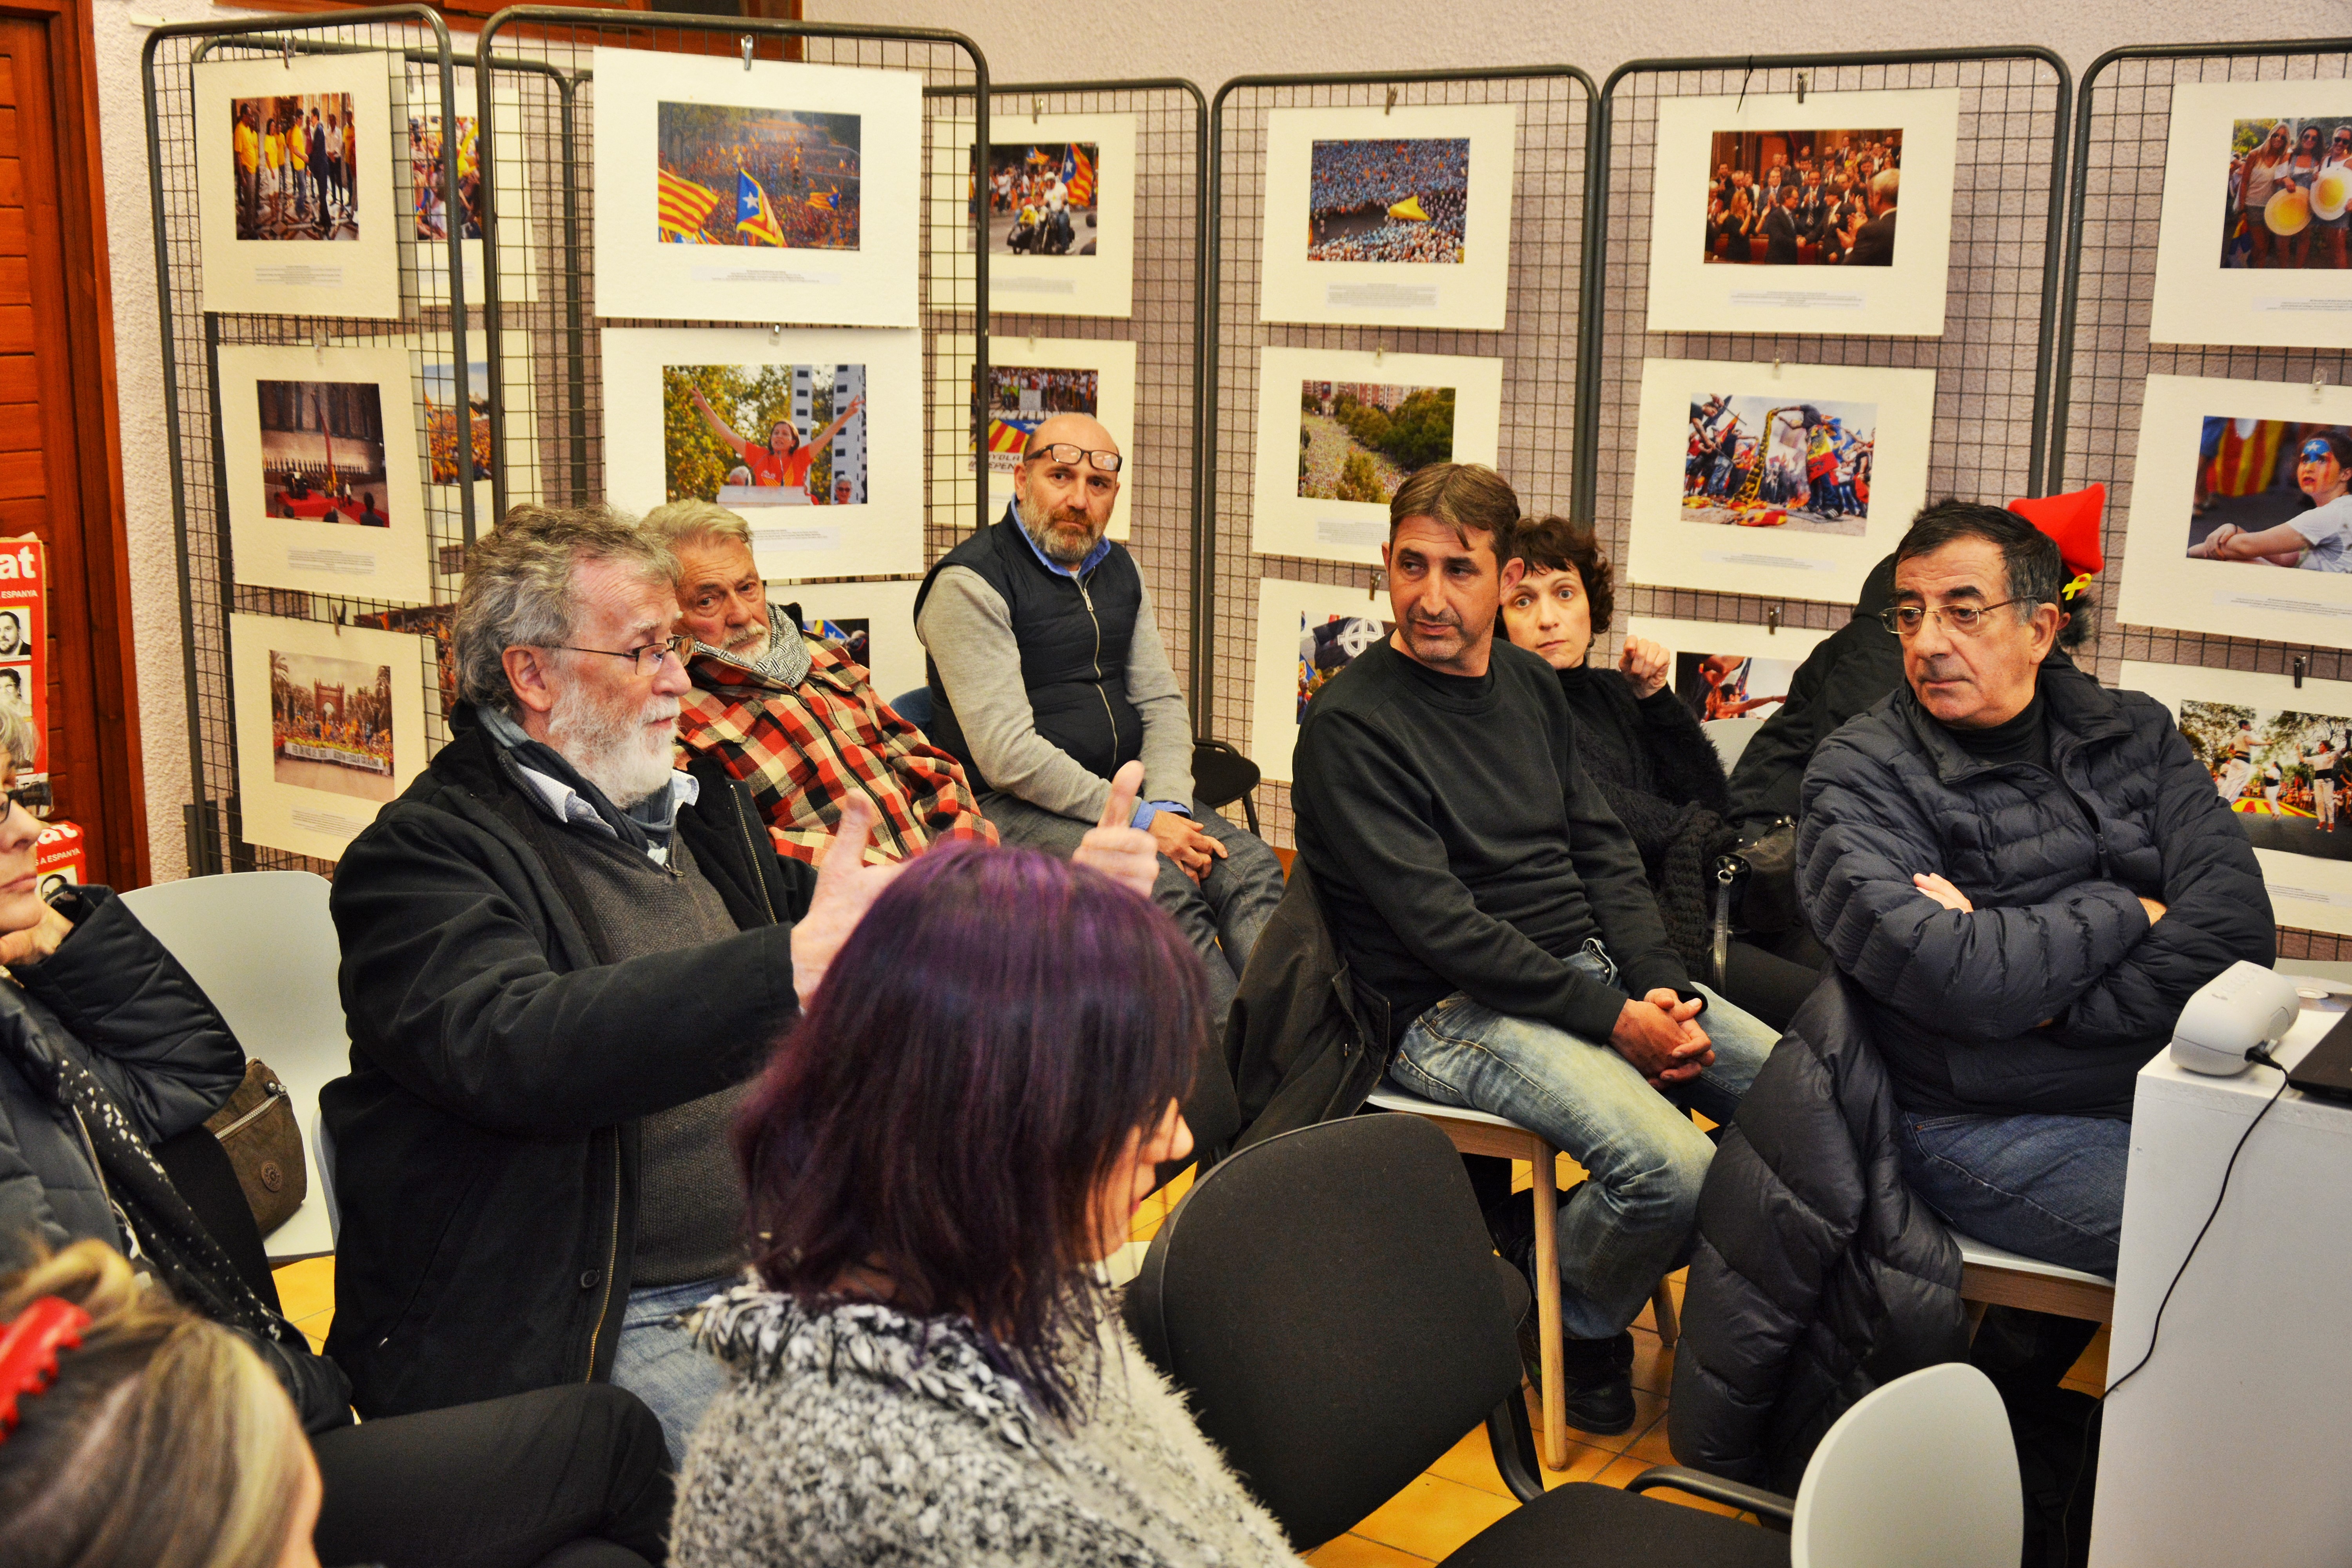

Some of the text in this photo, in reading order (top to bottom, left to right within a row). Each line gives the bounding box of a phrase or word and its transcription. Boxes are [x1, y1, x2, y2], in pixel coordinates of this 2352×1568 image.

[0, 545, 36, 579] at
[1, 590, 38, 599] ESPANYA
[35, 824, 78, 845] at
[47, 848, 81, 863] ESPANYA
